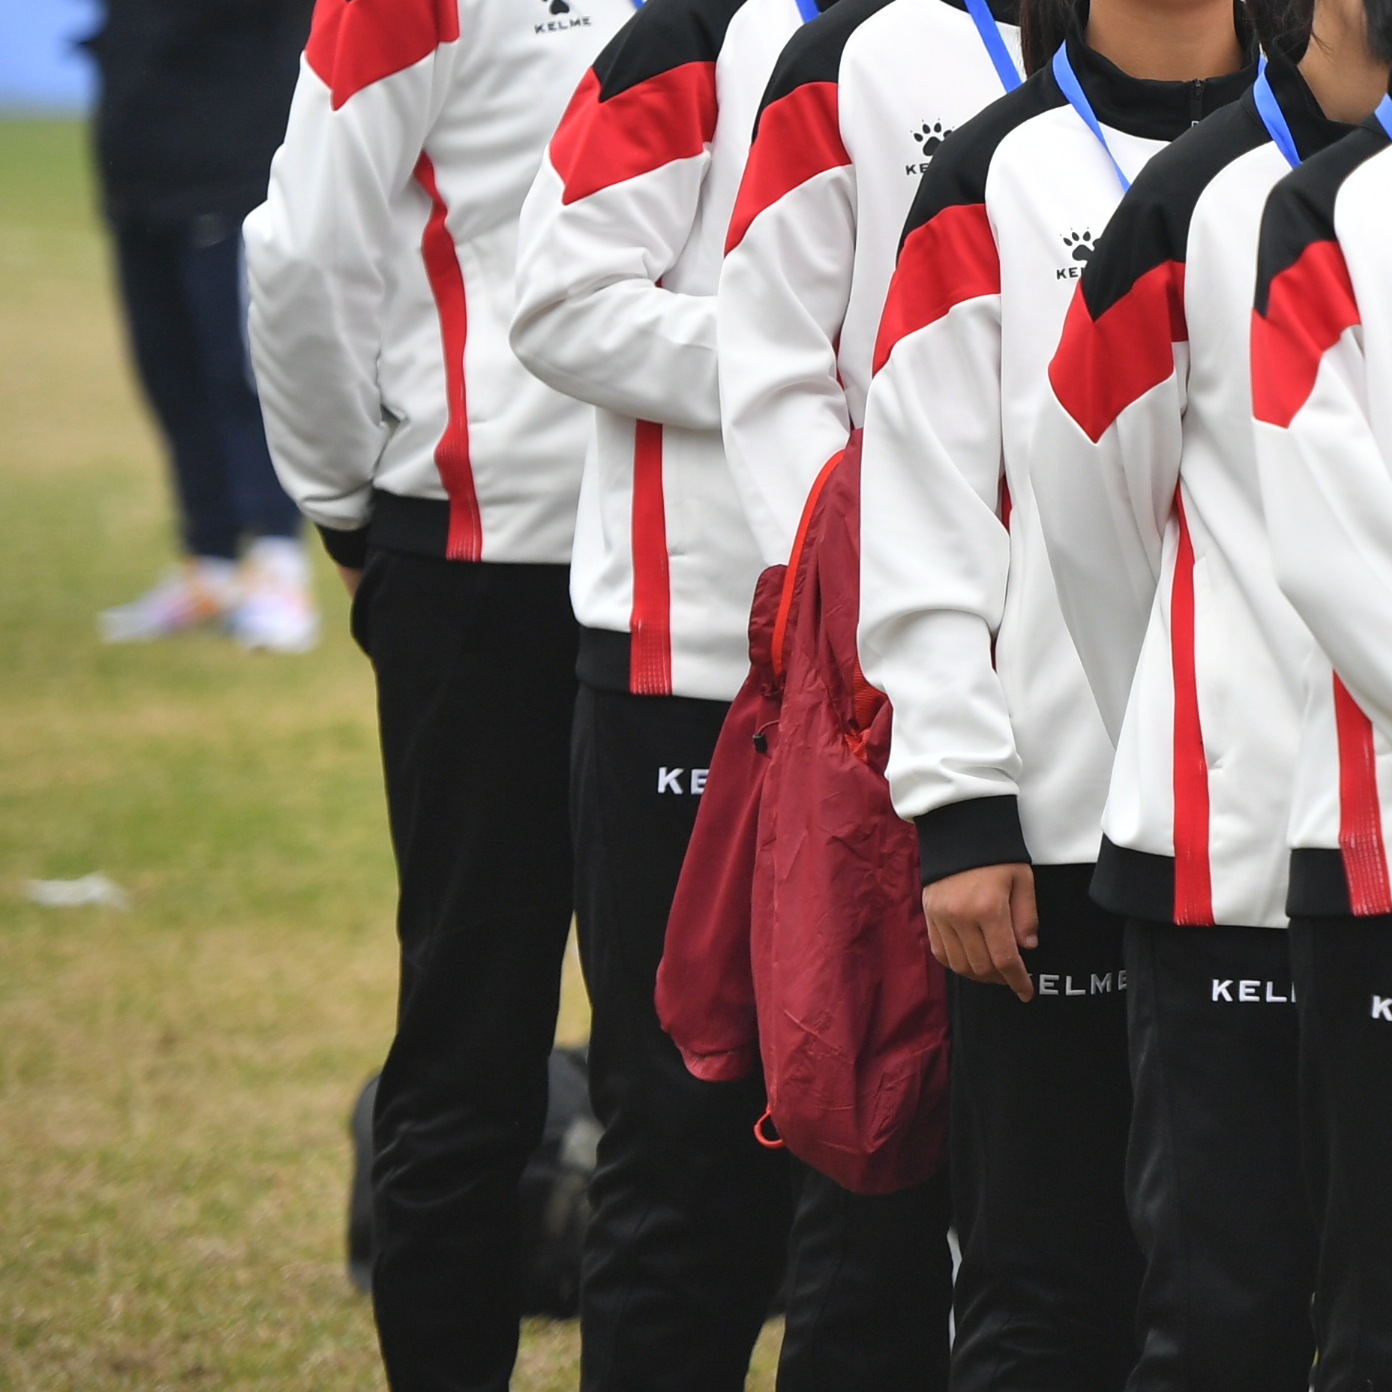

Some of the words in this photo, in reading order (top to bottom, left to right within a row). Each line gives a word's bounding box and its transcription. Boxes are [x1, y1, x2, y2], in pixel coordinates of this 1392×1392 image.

[534, 16, 592, 34] KELME
[1028, 970, 1127, 996] ELME
[1211, 979, 1297, 1002] KEL
